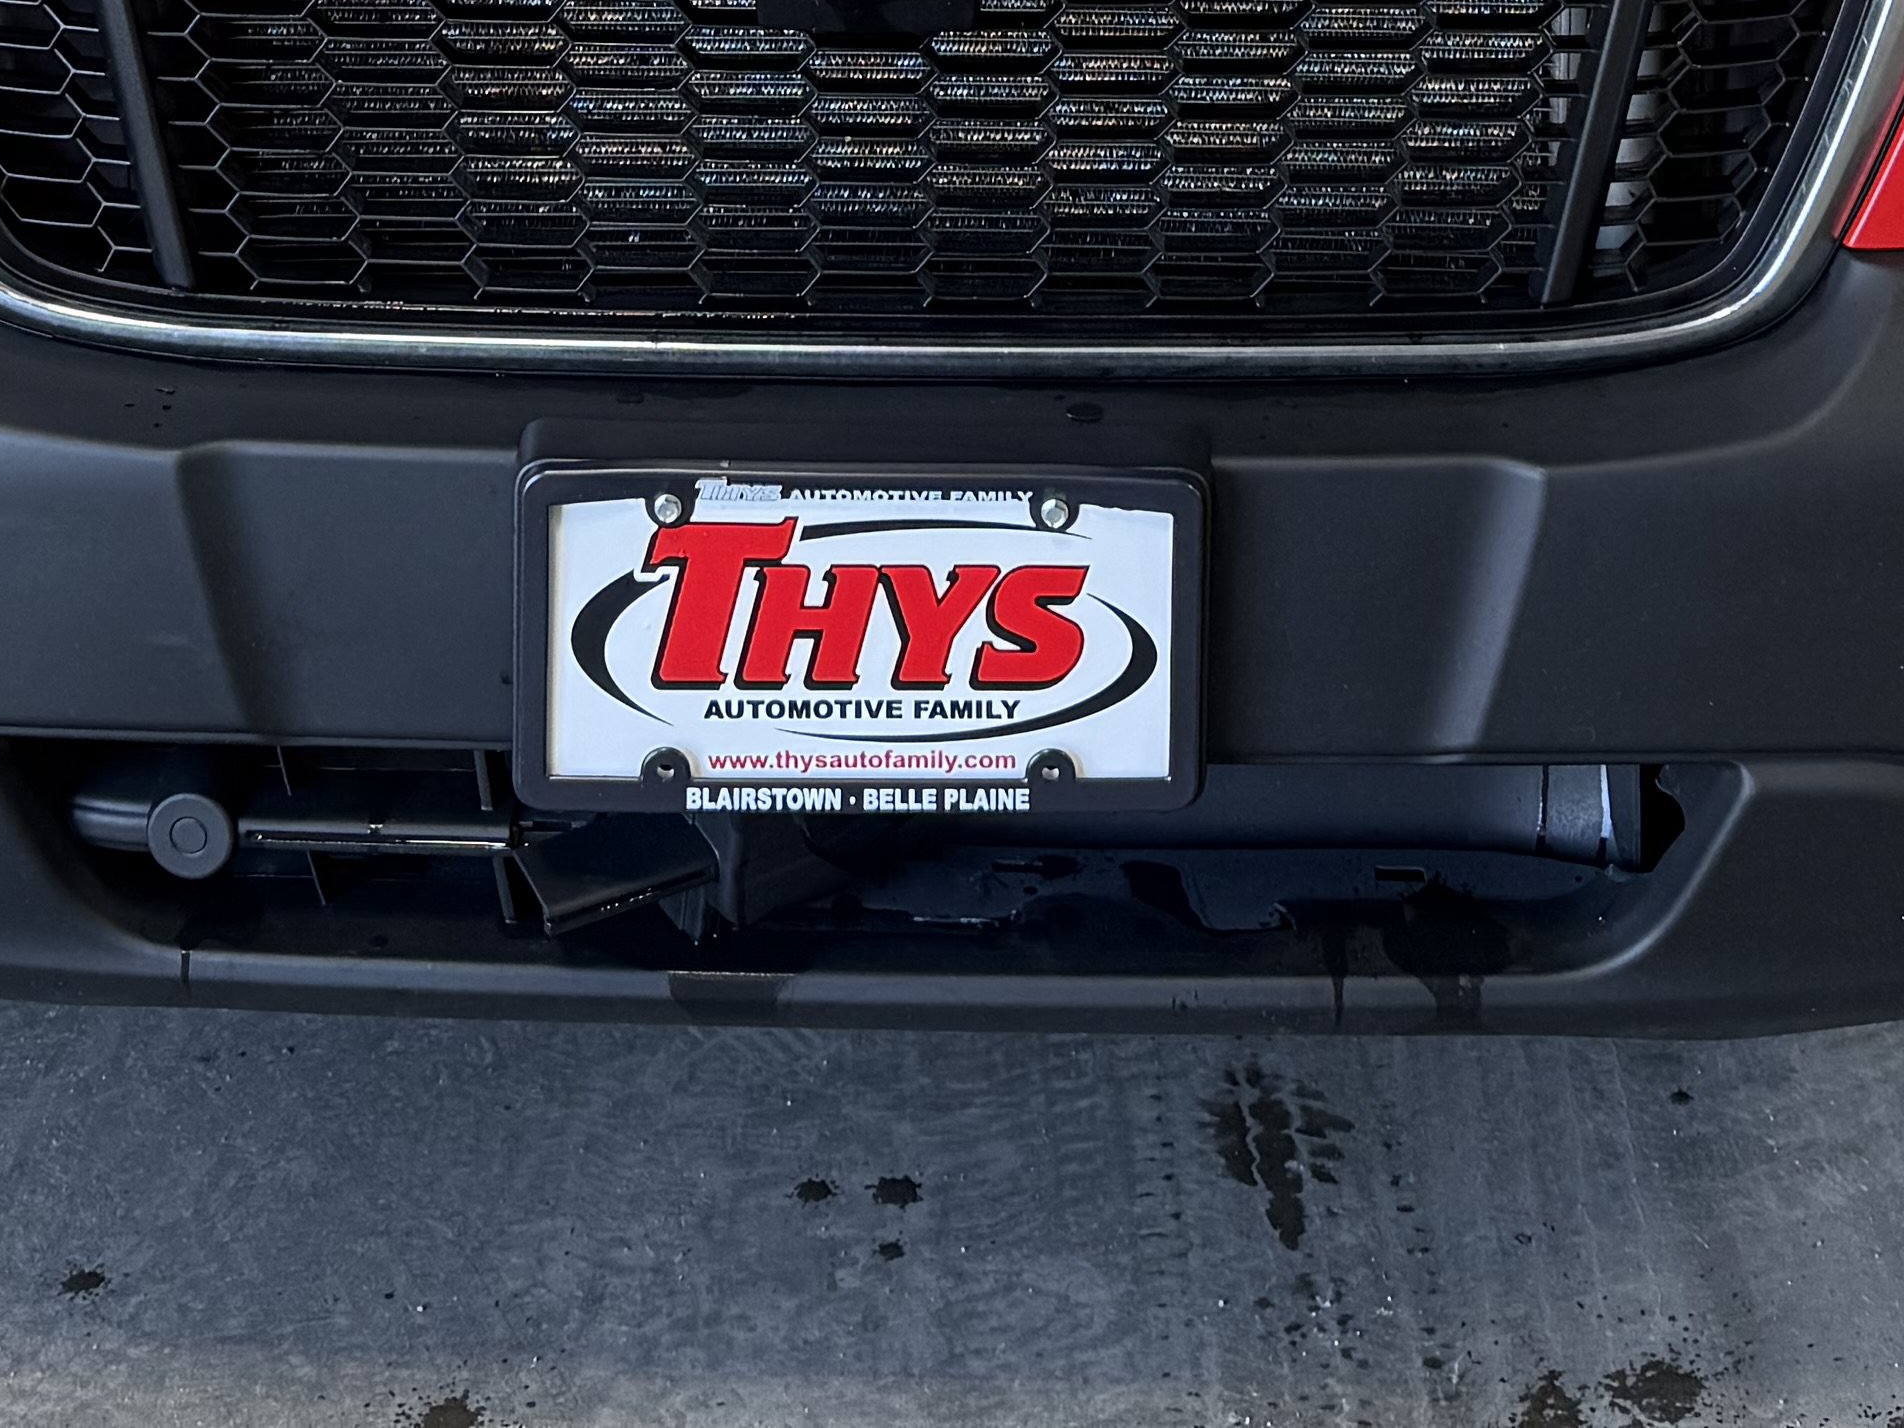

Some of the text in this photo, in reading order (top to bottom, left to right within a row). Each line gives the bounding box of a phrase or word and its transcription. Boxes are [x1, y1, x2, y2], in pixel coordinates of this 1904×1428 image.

[789, 489, 942, 502] AUTOMOTIVE
[950, 490, 1034, 502] FAMILY
[639, 517, 1091, 691] THYS
[704, 699, 1021, 720] AUTOMOTIVE FAMILY
[708, 749, 1016, 774] www.thysautofamily.com
[685, 787, 1030, 812] BLAIRSTOWN BELLE PLAINE
